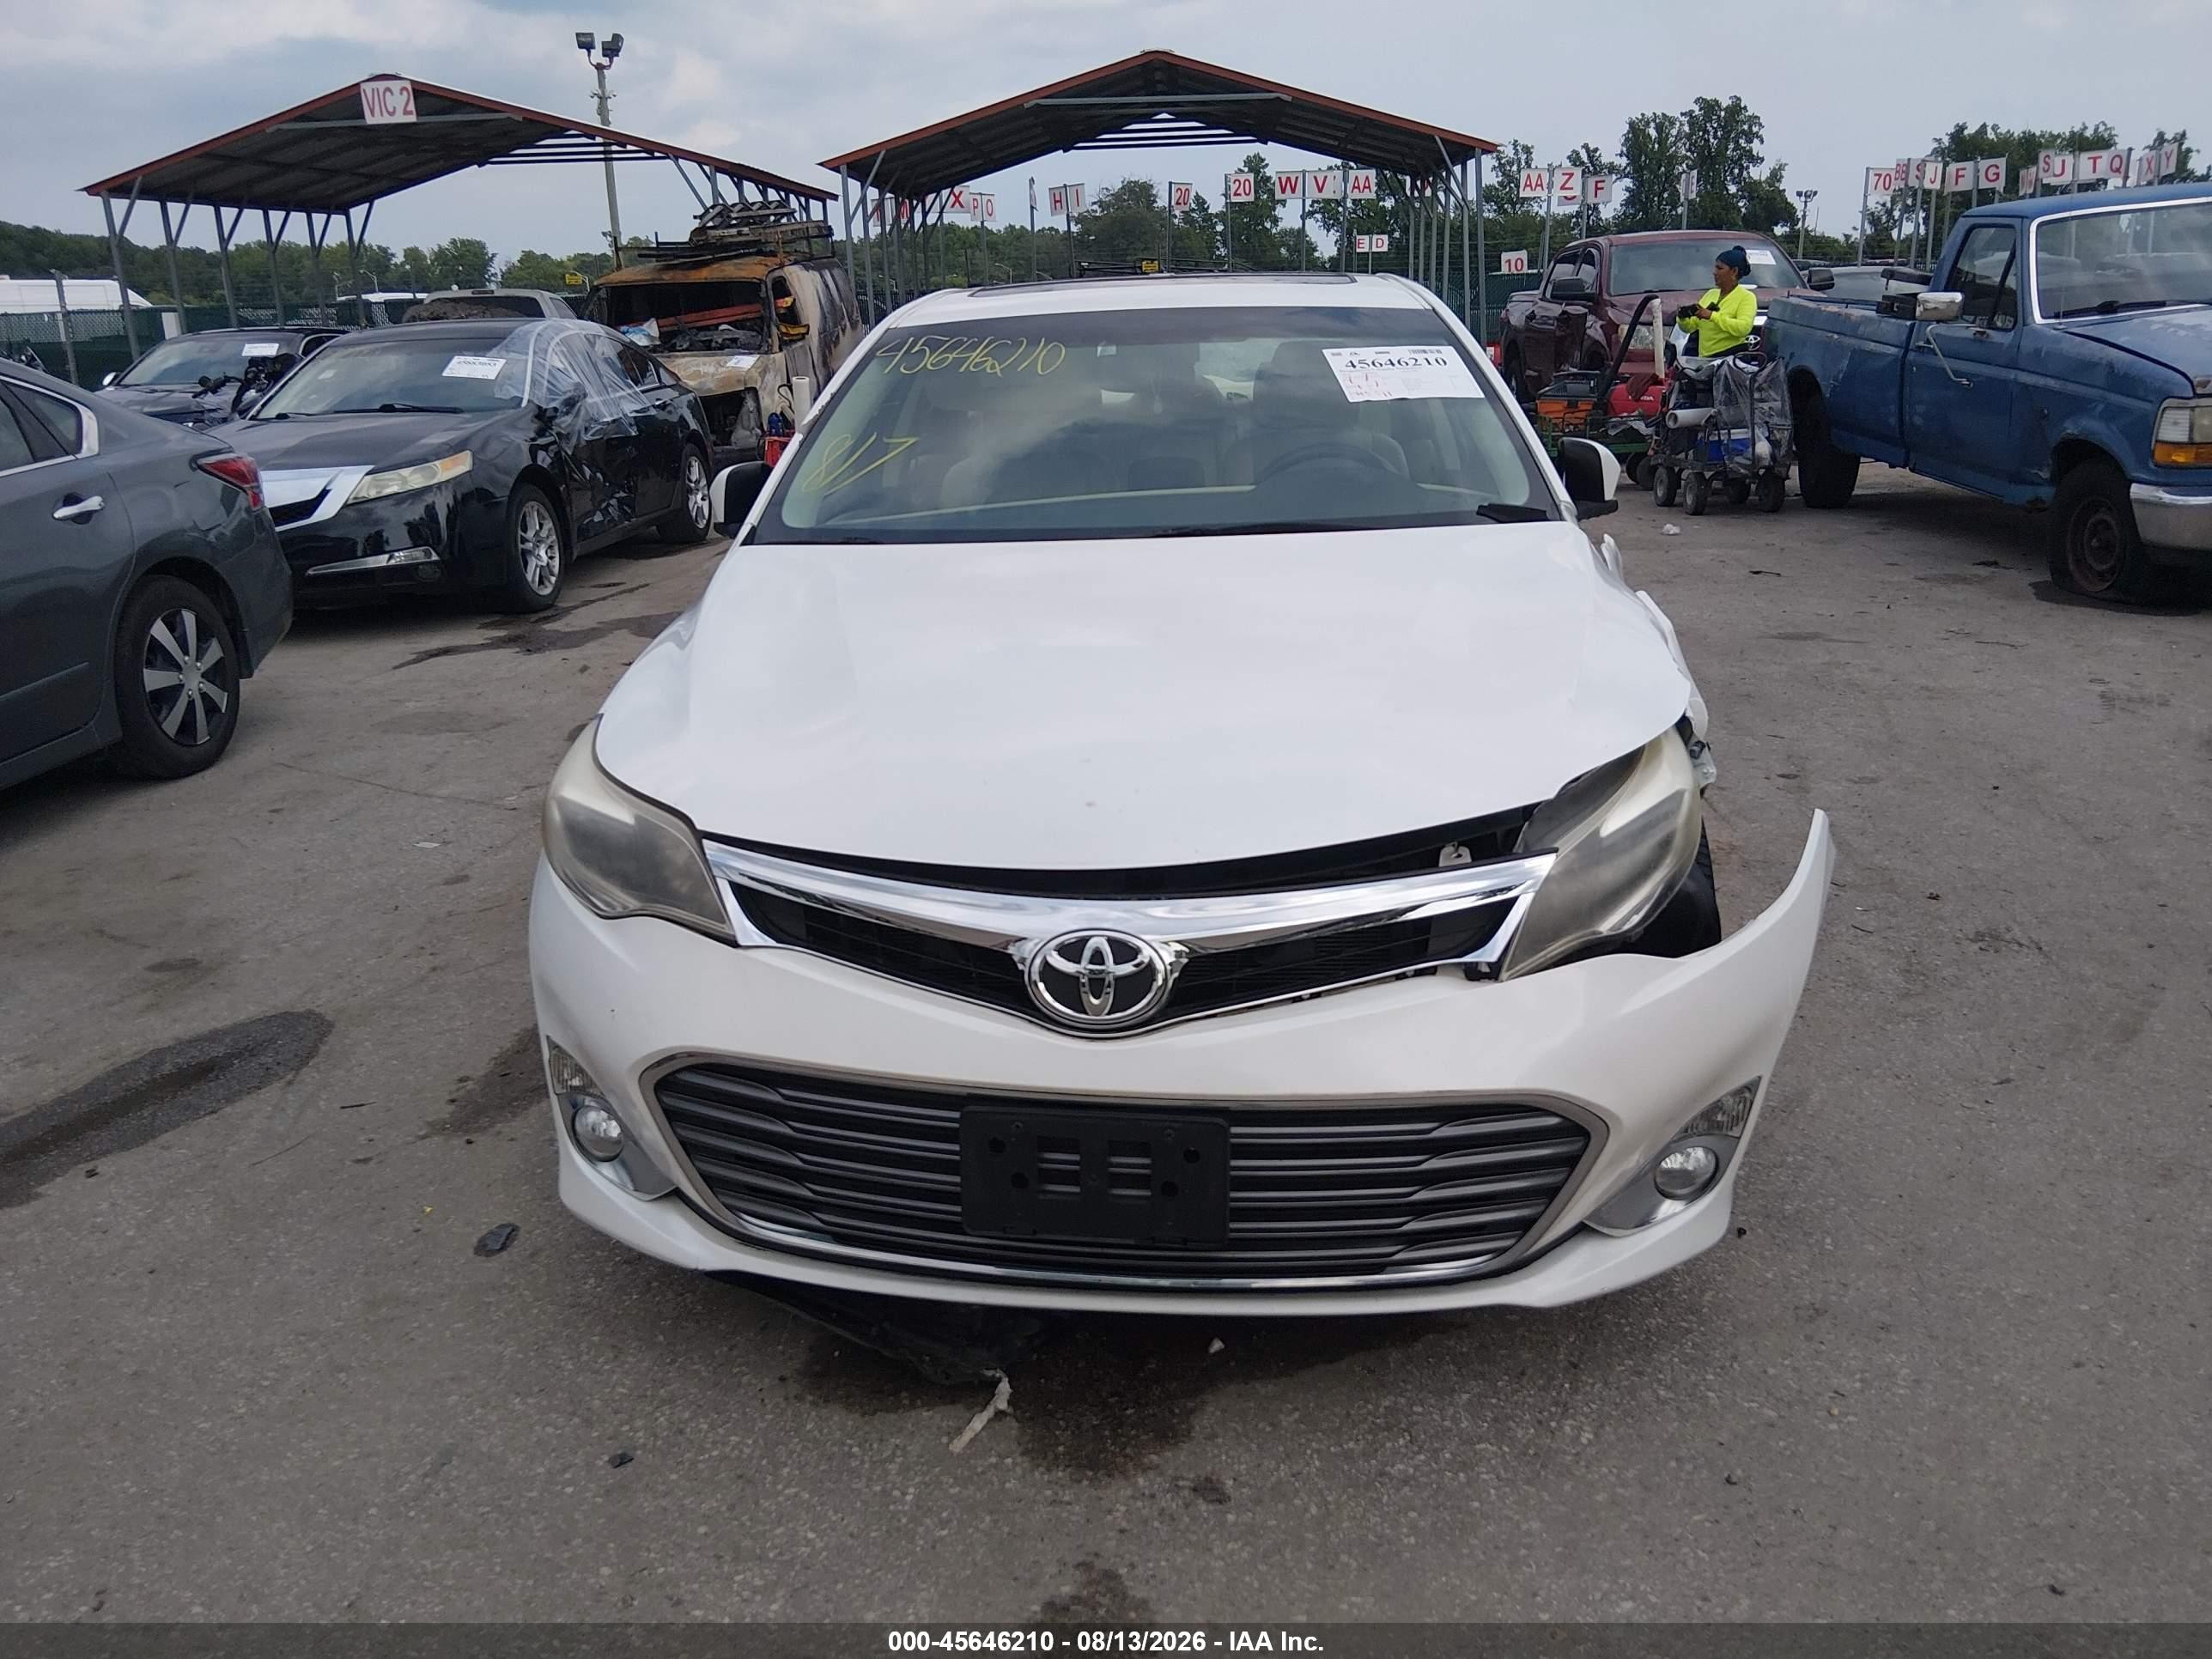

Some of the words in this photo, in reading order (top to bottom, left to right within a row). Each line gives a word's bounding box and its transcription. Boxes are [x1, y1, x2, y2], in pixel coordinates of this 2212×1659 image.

[363, 87, 396, 117] VIC
[399, 87, 413, 116] 2
[2043, 154, 2051, 173] S
[2087, 155, 2102, 173] T
[2109, 154, 2123, 174] Q
[1522, 173, 1545, 191] AA
[1559, 173, 1574, 191] Z
[1874, 173, 1892, 191] 70
[1954, 167, 1966, 186] F
[1984, 164, 2000, 182] G
[1232, 178, 1252, 197] 20
[1278, 176, 1299, 195] W
[1313, 175, 1328, 194] V
[1351, 175, 1372, 193] AA
[1594, 179, 1606, 198] F
[951, 191, 965, 209] X
[1053, 191, 1063, 210] H
[1175, 187, 1191, 206] 20
[1357, 238, 1365, 249] E
[1376, 238, 1384, 249] D
[1504, 258, 1524, 273] 10
[1345, 356, 1448, 369] 45646210
